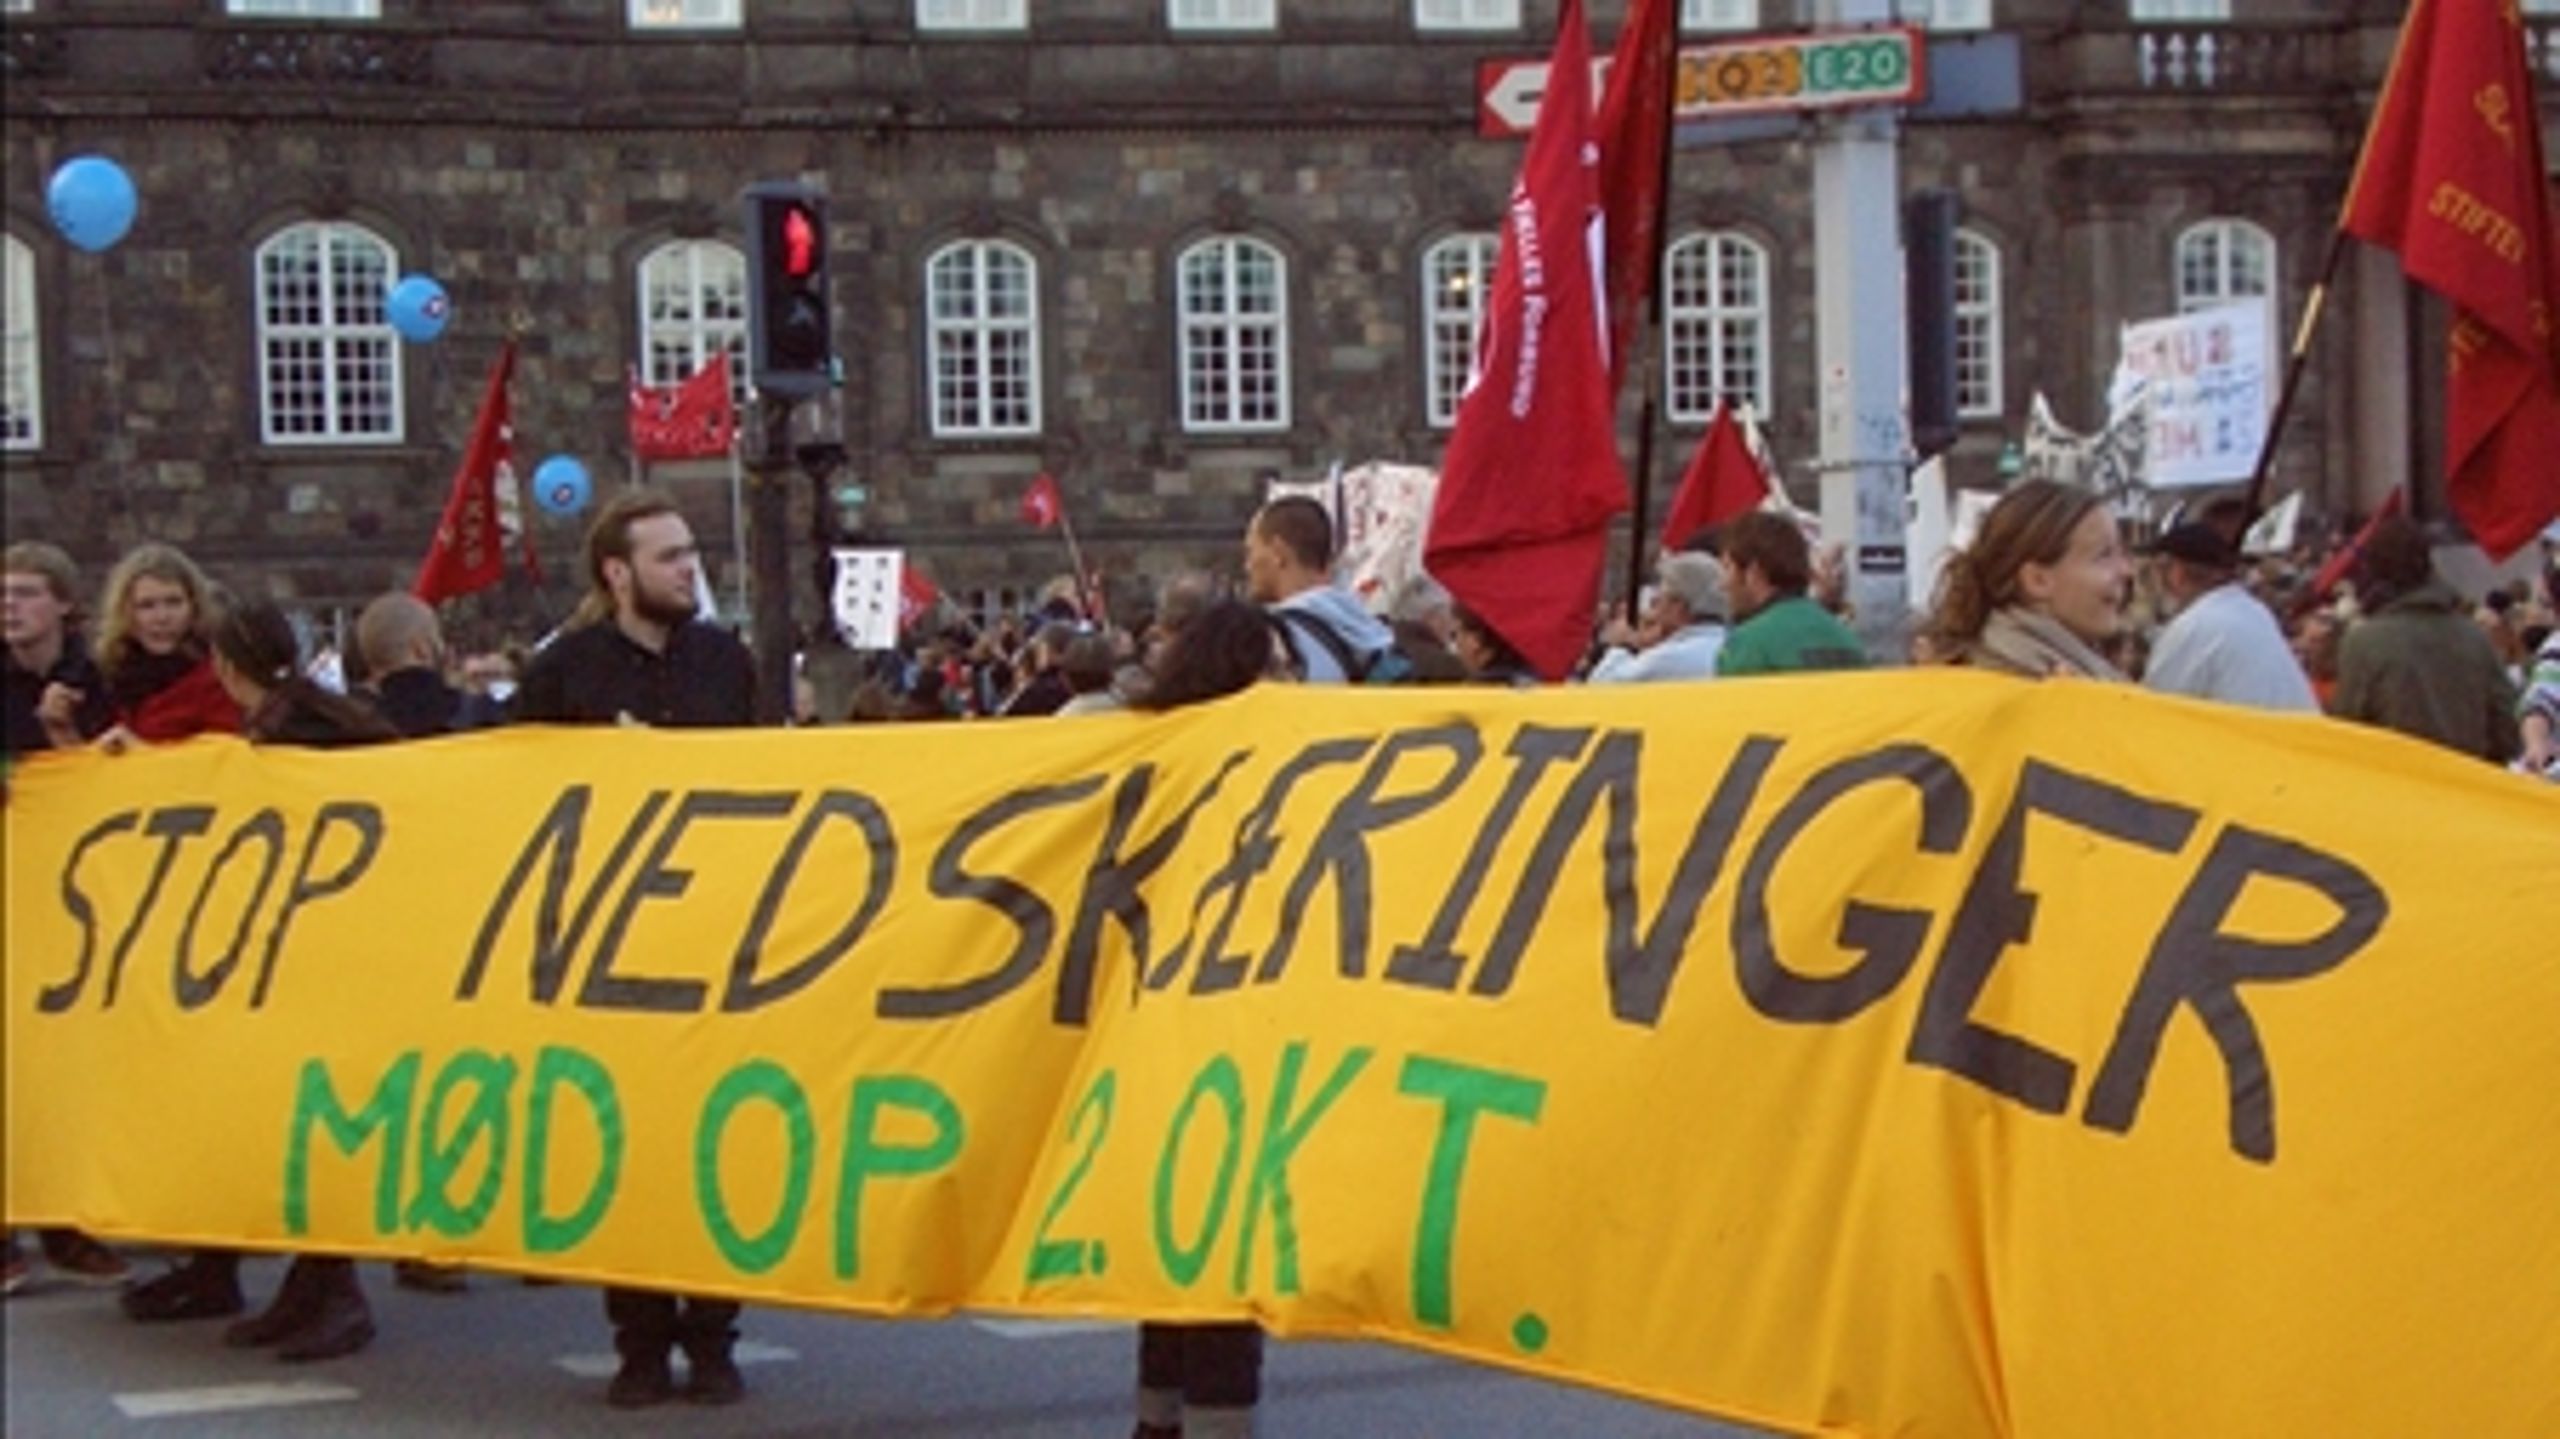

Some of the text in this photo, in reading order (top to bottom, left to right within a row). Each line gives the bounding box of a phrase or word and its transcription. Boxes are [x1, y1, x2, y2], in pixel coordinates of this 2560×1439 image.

[1812, 43, 1899, 88] E20
[37, 801, 384, 1013] STOP
[284, 1042, 1547, 1351] MØD OP 2. OKT.
